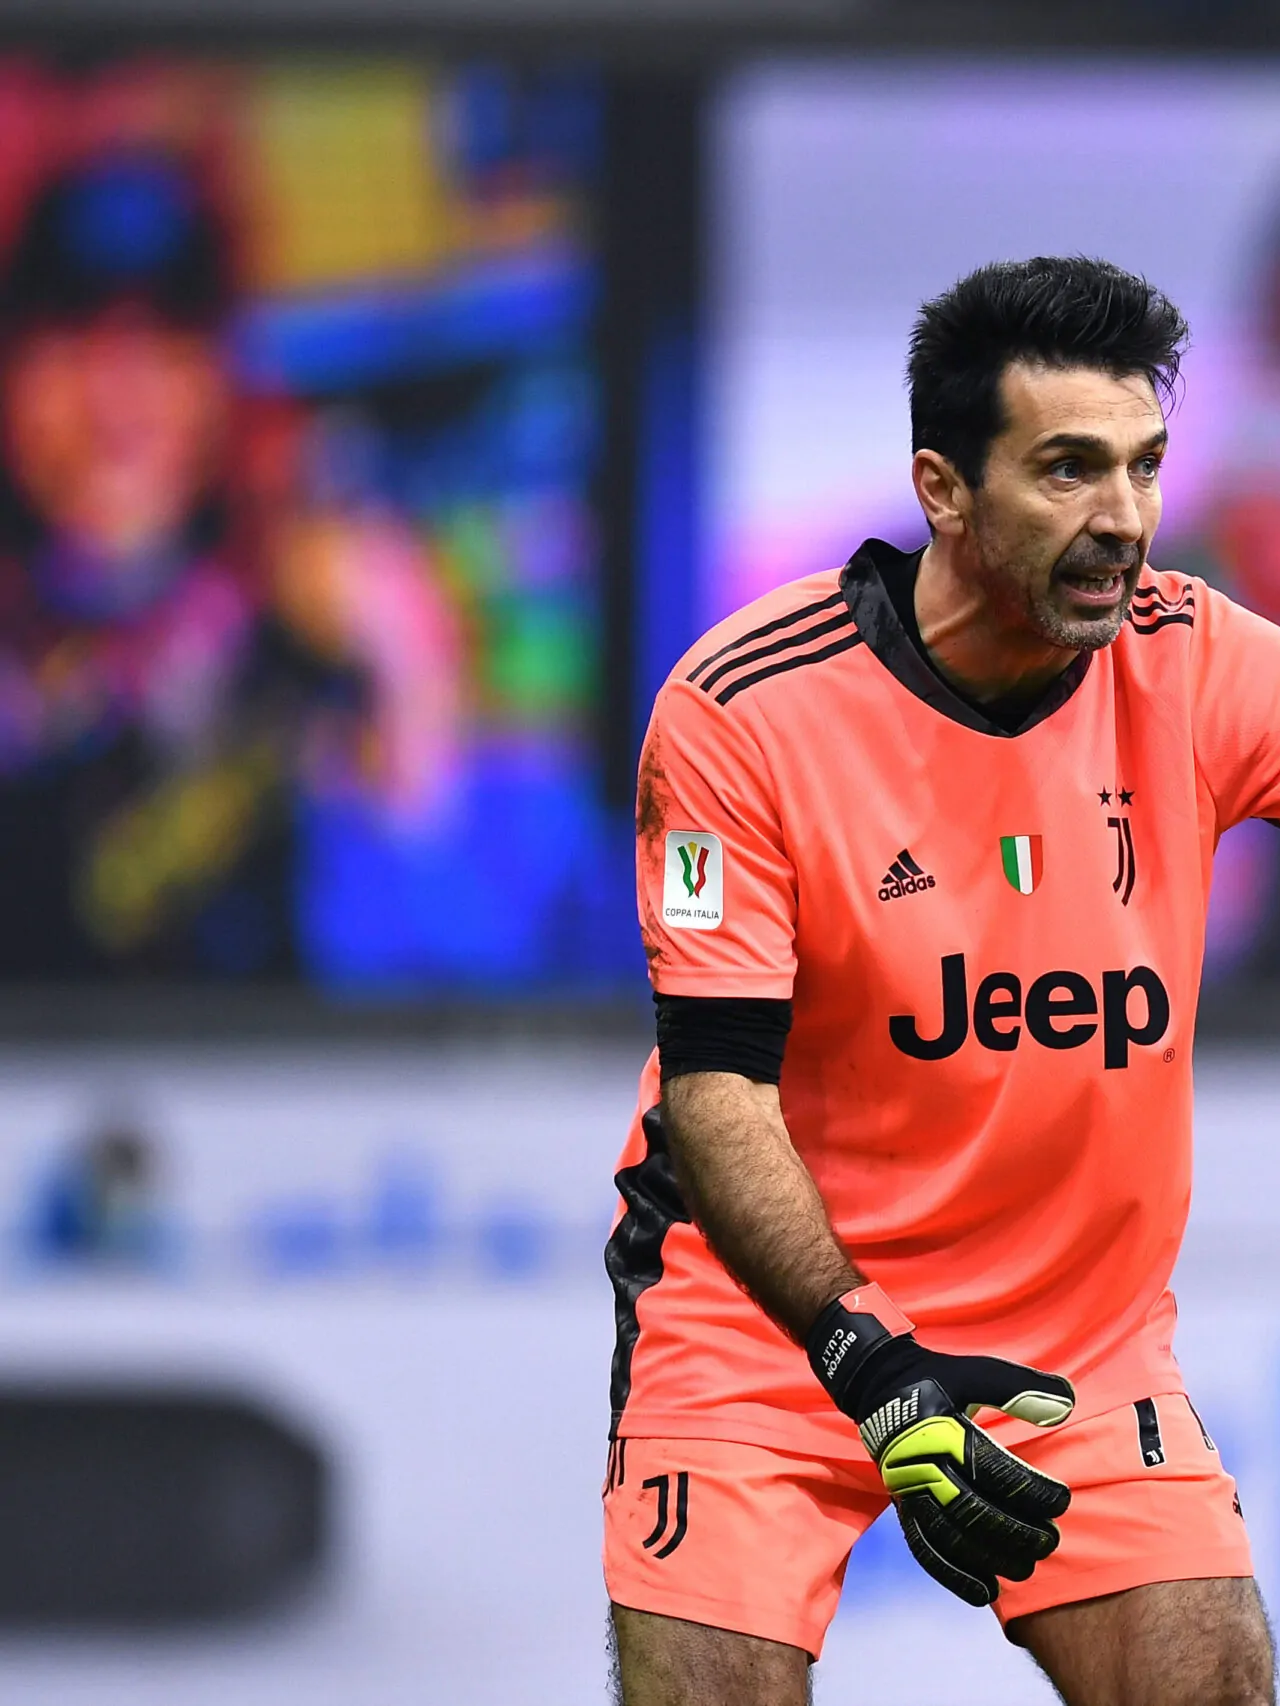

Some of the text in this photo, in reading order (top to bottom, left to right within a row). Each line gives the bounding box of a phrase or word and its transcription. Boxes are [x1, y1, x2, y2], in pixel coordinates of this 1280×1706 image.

[878, 875, 936, 902] adidas
[665, 908, 720, 919] COPPA ITALIA
[889, 953, 1170, 1070] Jeep
[827, 1331, 857, 1380] BUFFON
